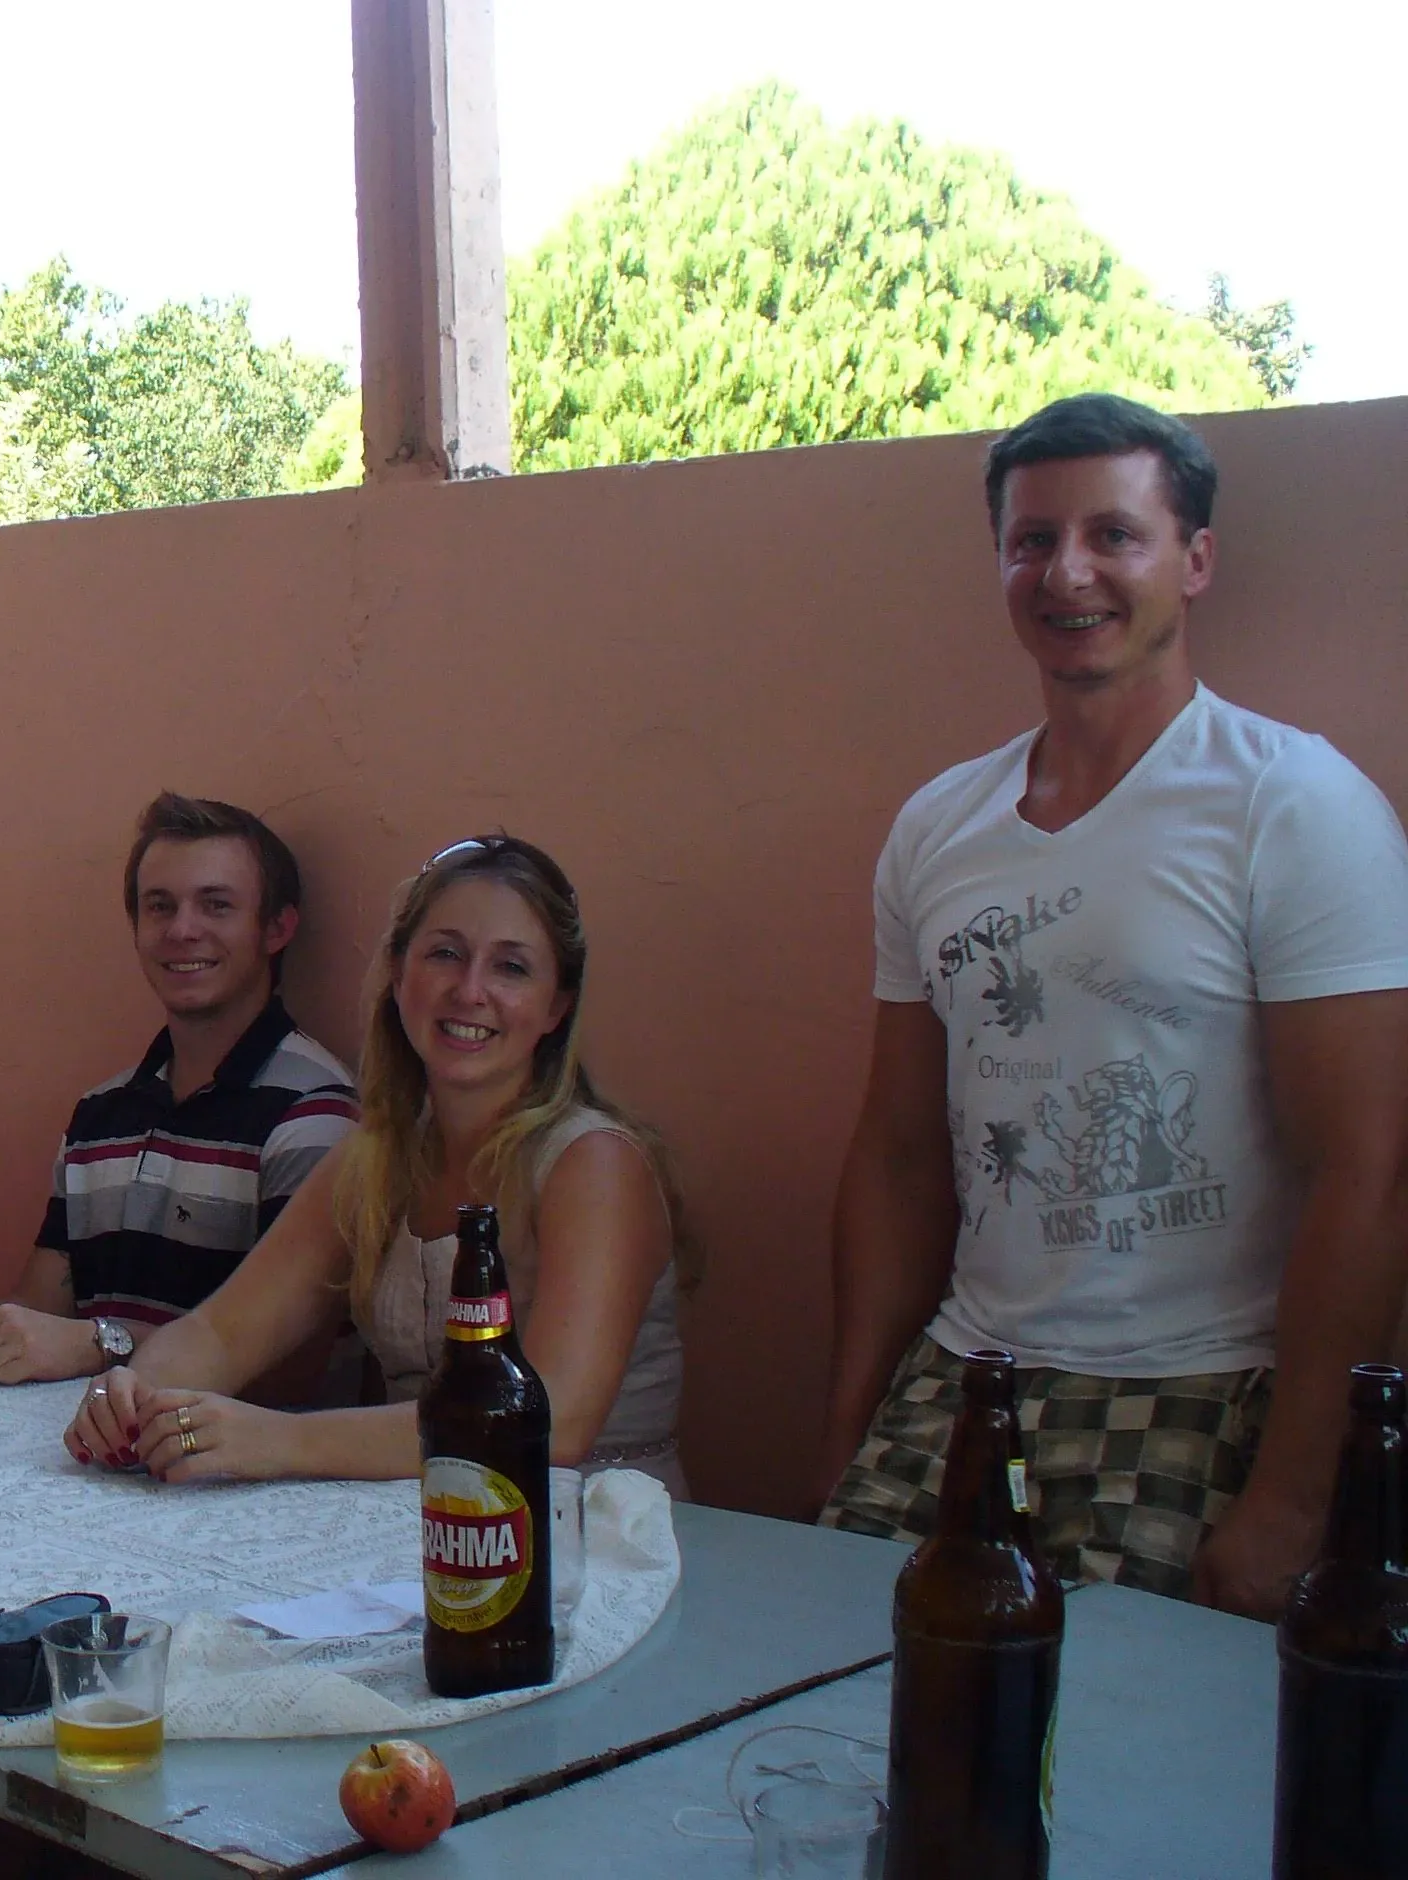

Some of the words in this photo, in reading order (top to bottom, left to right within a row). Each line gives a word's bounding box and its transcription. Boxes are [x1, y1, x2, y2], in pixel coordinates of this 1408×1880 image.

[978, 1055, 1063, 1086] Original
[1038, 1203, 1102, 1246] KINGS
[1106, 1216, 1137, 1253] OF
[1137, 1183, 1228, 1232] STREET
